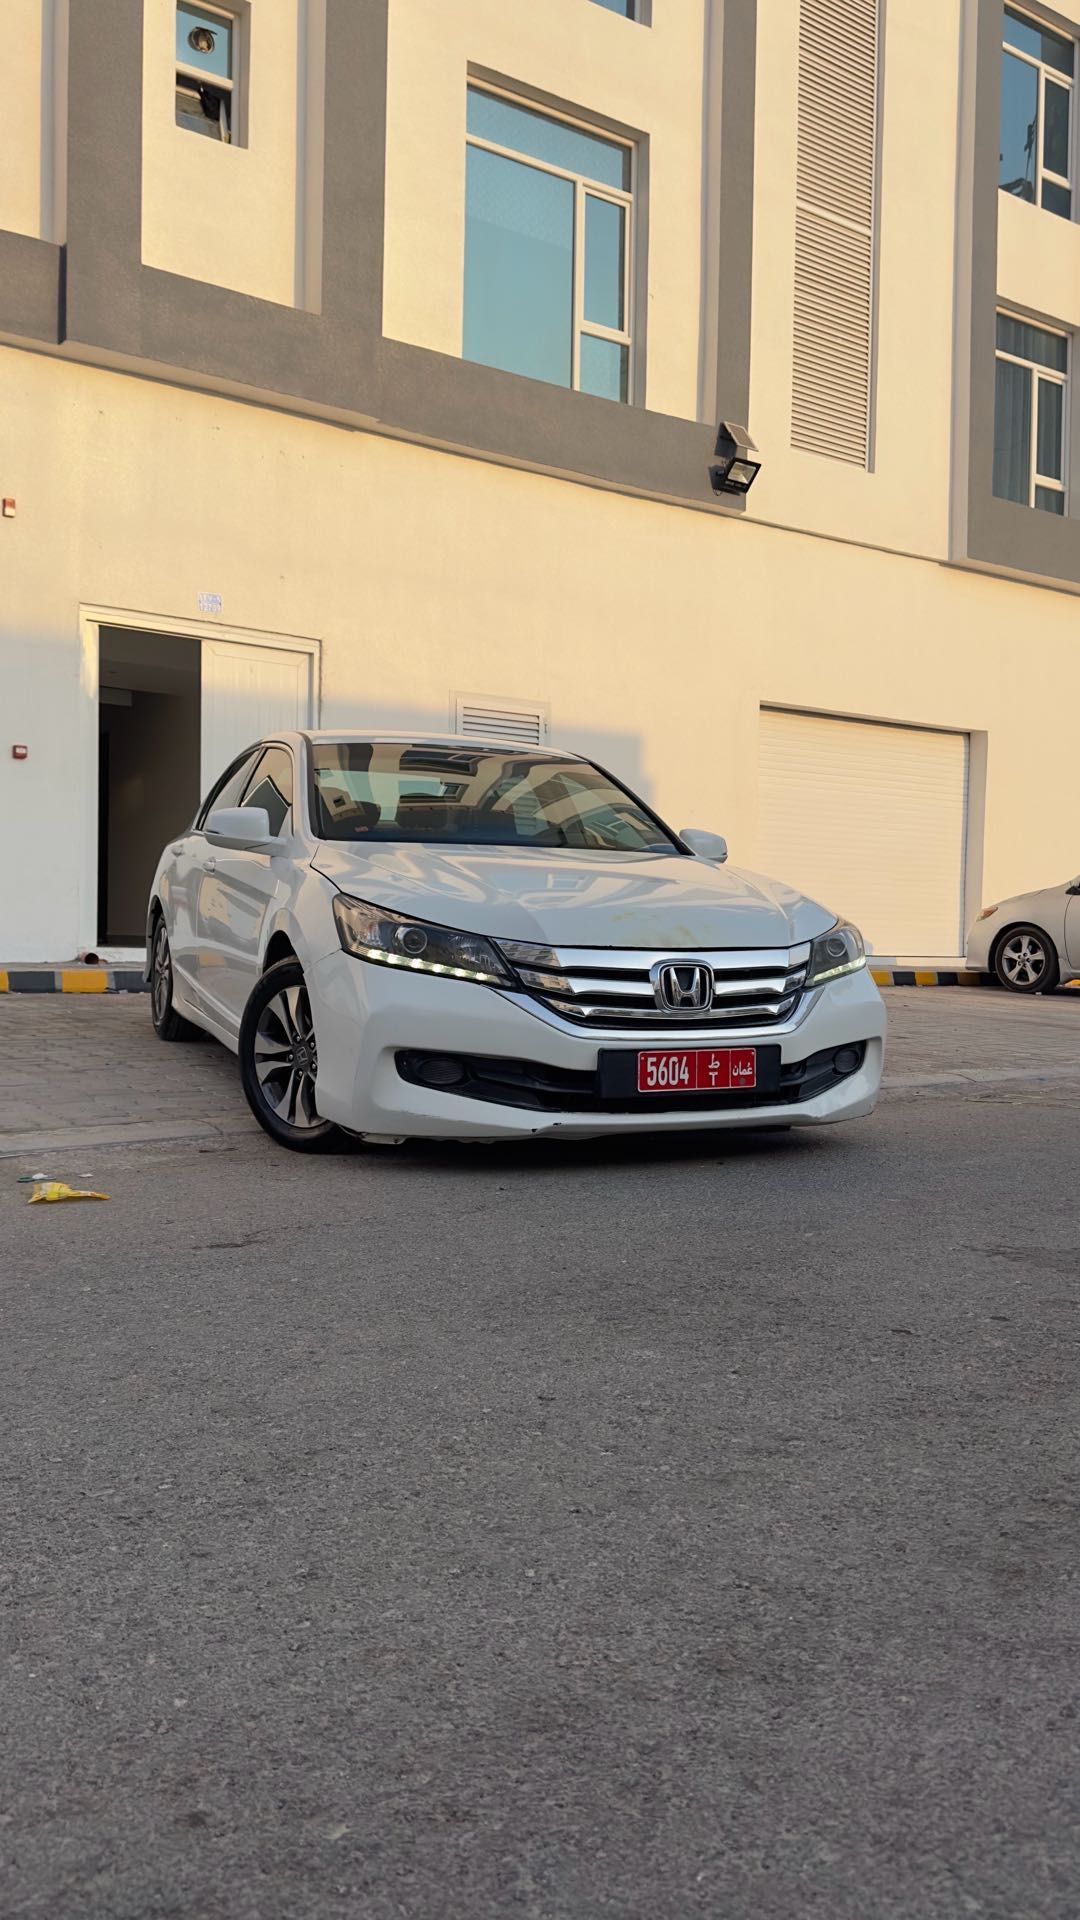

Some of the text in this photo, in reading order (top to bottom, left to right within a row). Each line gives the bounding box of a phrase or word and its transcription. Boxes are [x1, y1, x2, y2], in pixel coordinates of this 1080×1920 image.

[707, 1053, 720, 1069] ط
[646, 1056, 689, 1086] 5604
[708, 1071, 719, 1086] T
